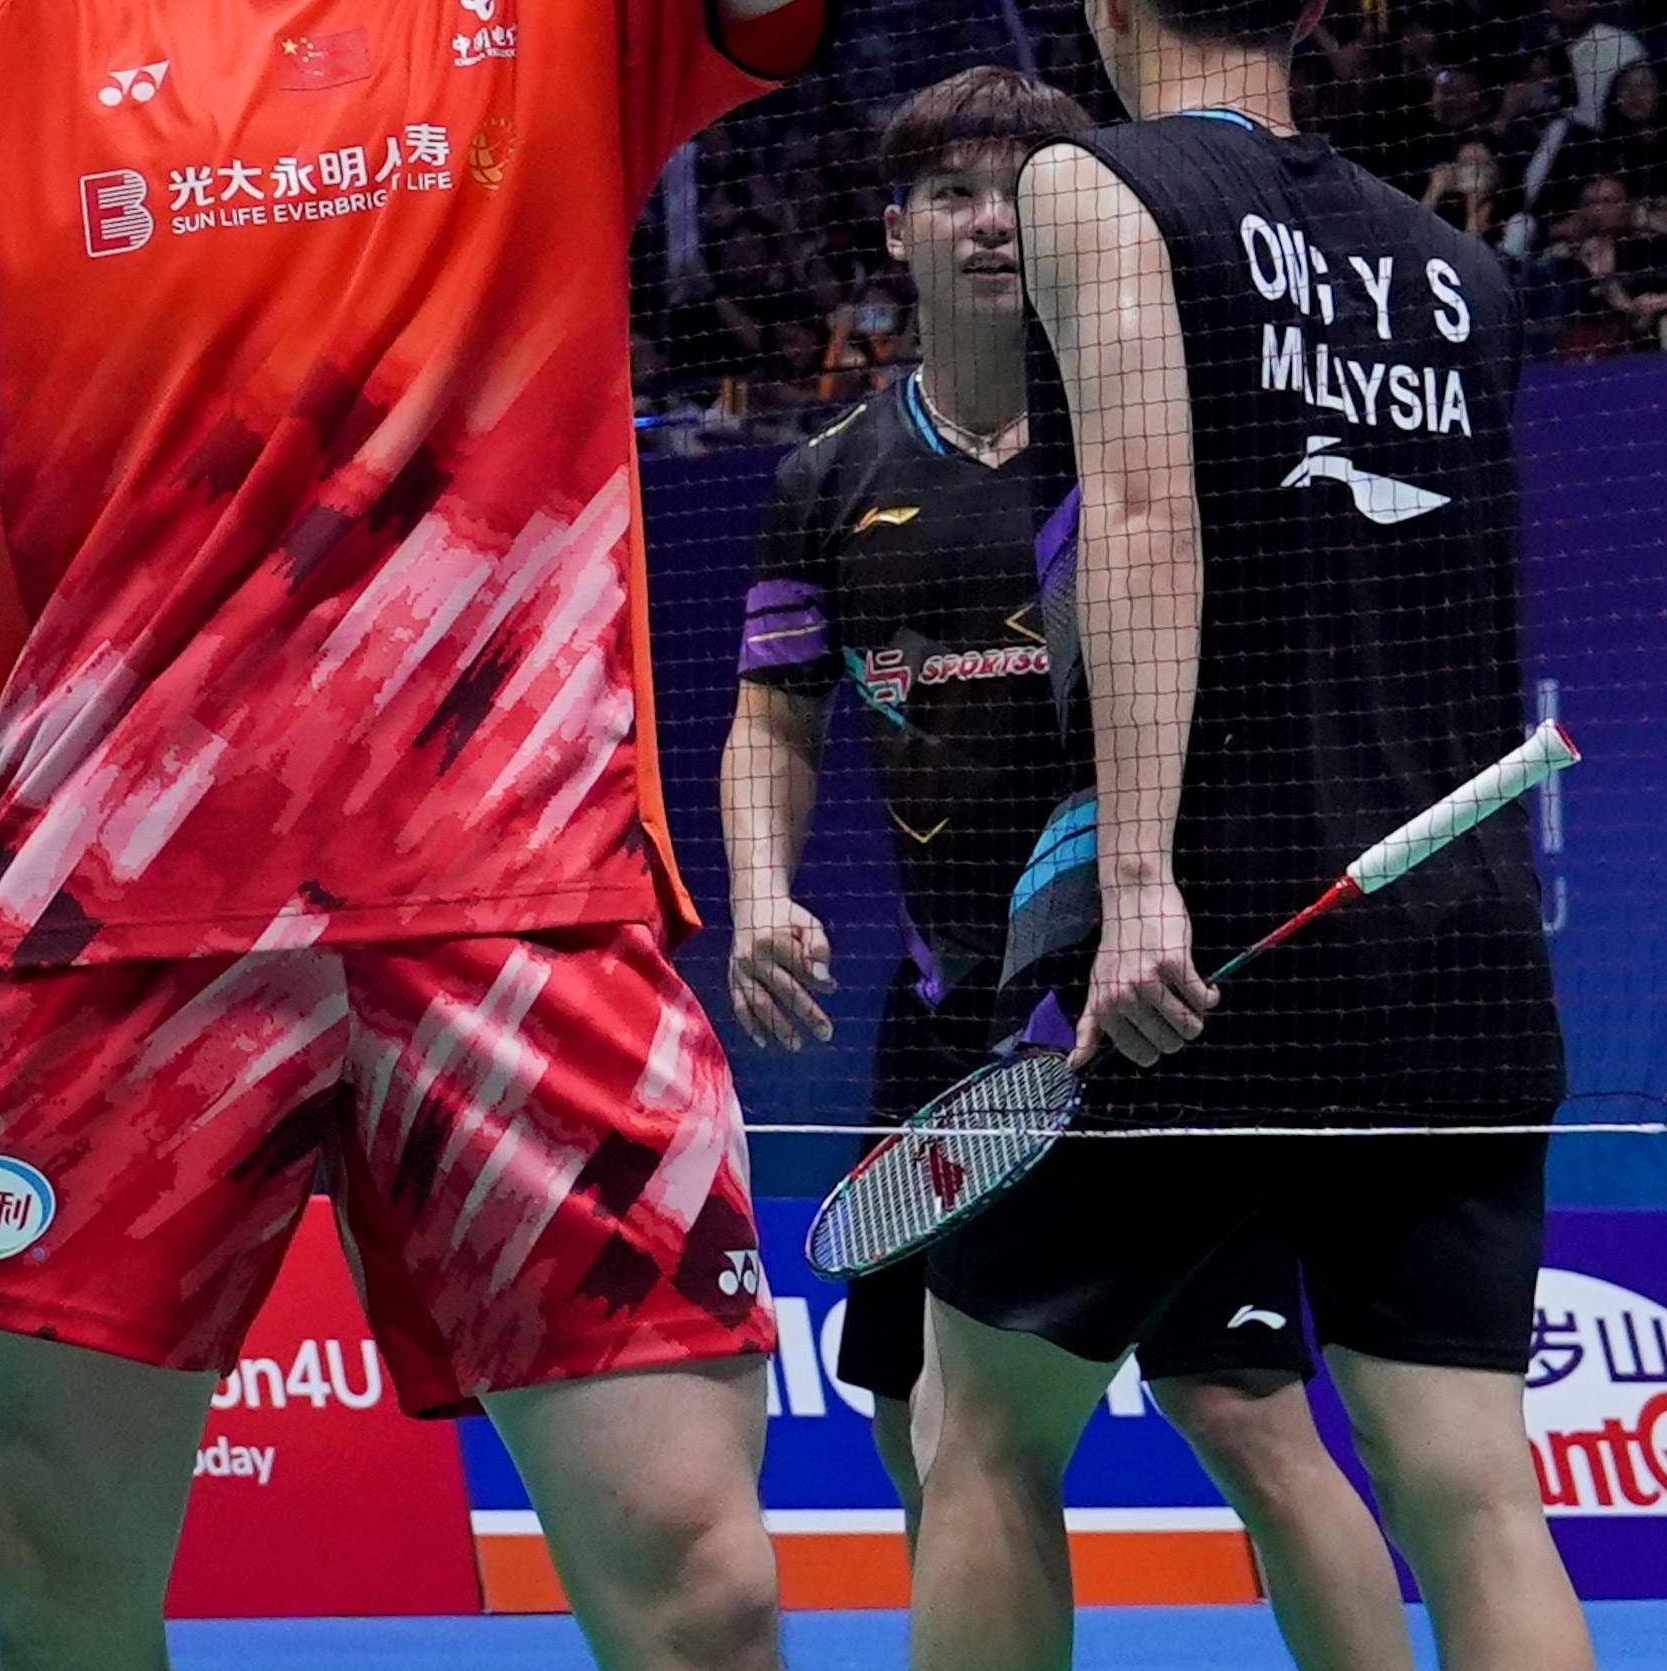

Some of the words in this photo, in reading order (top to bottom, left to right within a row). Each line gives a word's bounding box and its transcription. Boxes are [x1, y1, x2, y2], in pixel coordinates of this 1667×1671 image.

[172, 211, 216, 235] SUN
[220, 205, 267, 227] LIFE
[273, 172, 401, 224] EVERBRIGT
[408, 171, 453, 191] LIFE
[1348, 255, 1393, 340] Y
[1425, 258, 1471, 343] S
